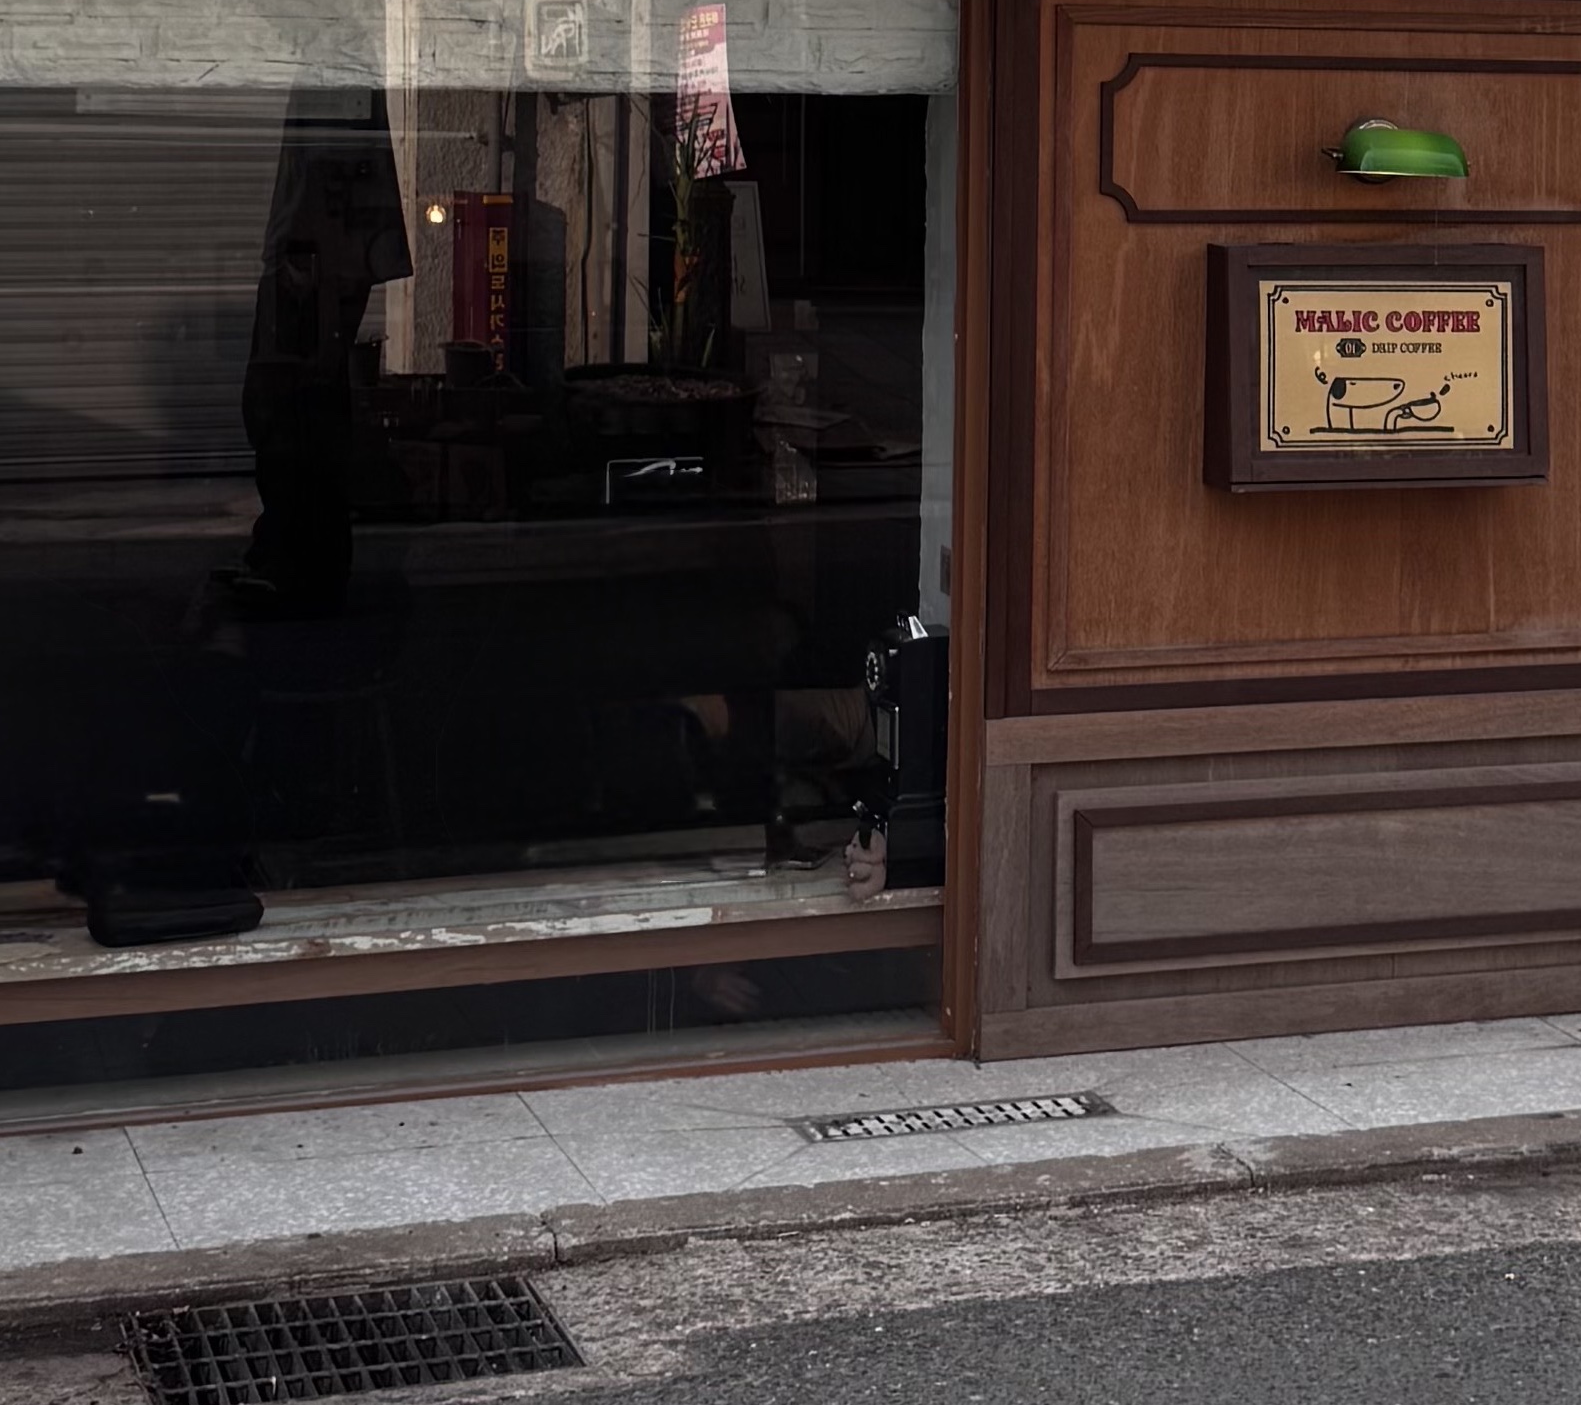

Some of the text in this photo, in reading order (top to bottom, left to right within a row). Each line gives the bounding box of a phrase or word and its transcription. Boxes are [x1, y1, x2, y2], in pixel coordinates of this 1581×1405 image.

[1295, 310, 1481, 333] MALIC COFFEE
[1371, 342, 1397, 354] DRIP
[1400, 342, 1442, 354] COFFEE
